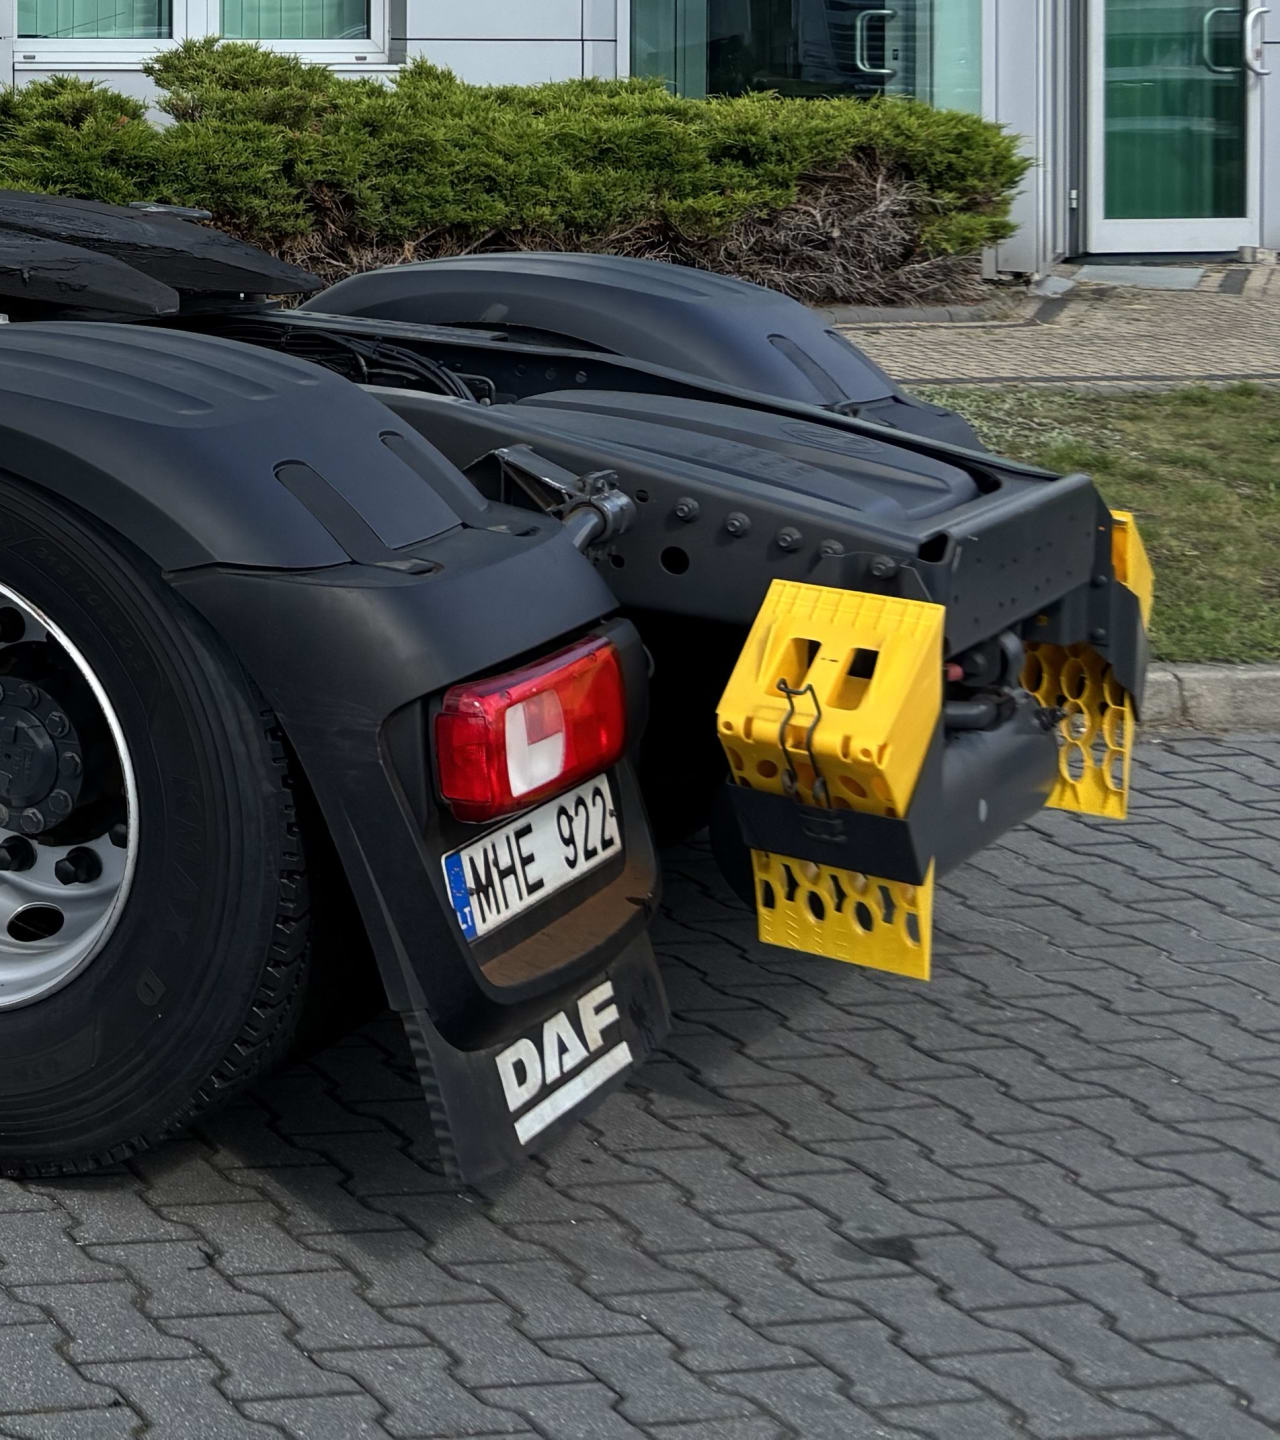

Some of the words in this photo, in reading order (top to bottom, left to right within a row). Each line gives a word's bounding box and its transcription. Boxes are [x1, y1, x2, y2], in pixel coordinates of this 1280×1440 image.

[456, 906, 473, 930] LT
[469, 822, 544, 924] MHE
[556, 786, 614, 870] 922
[495, 980, 620, 1112] DAF
